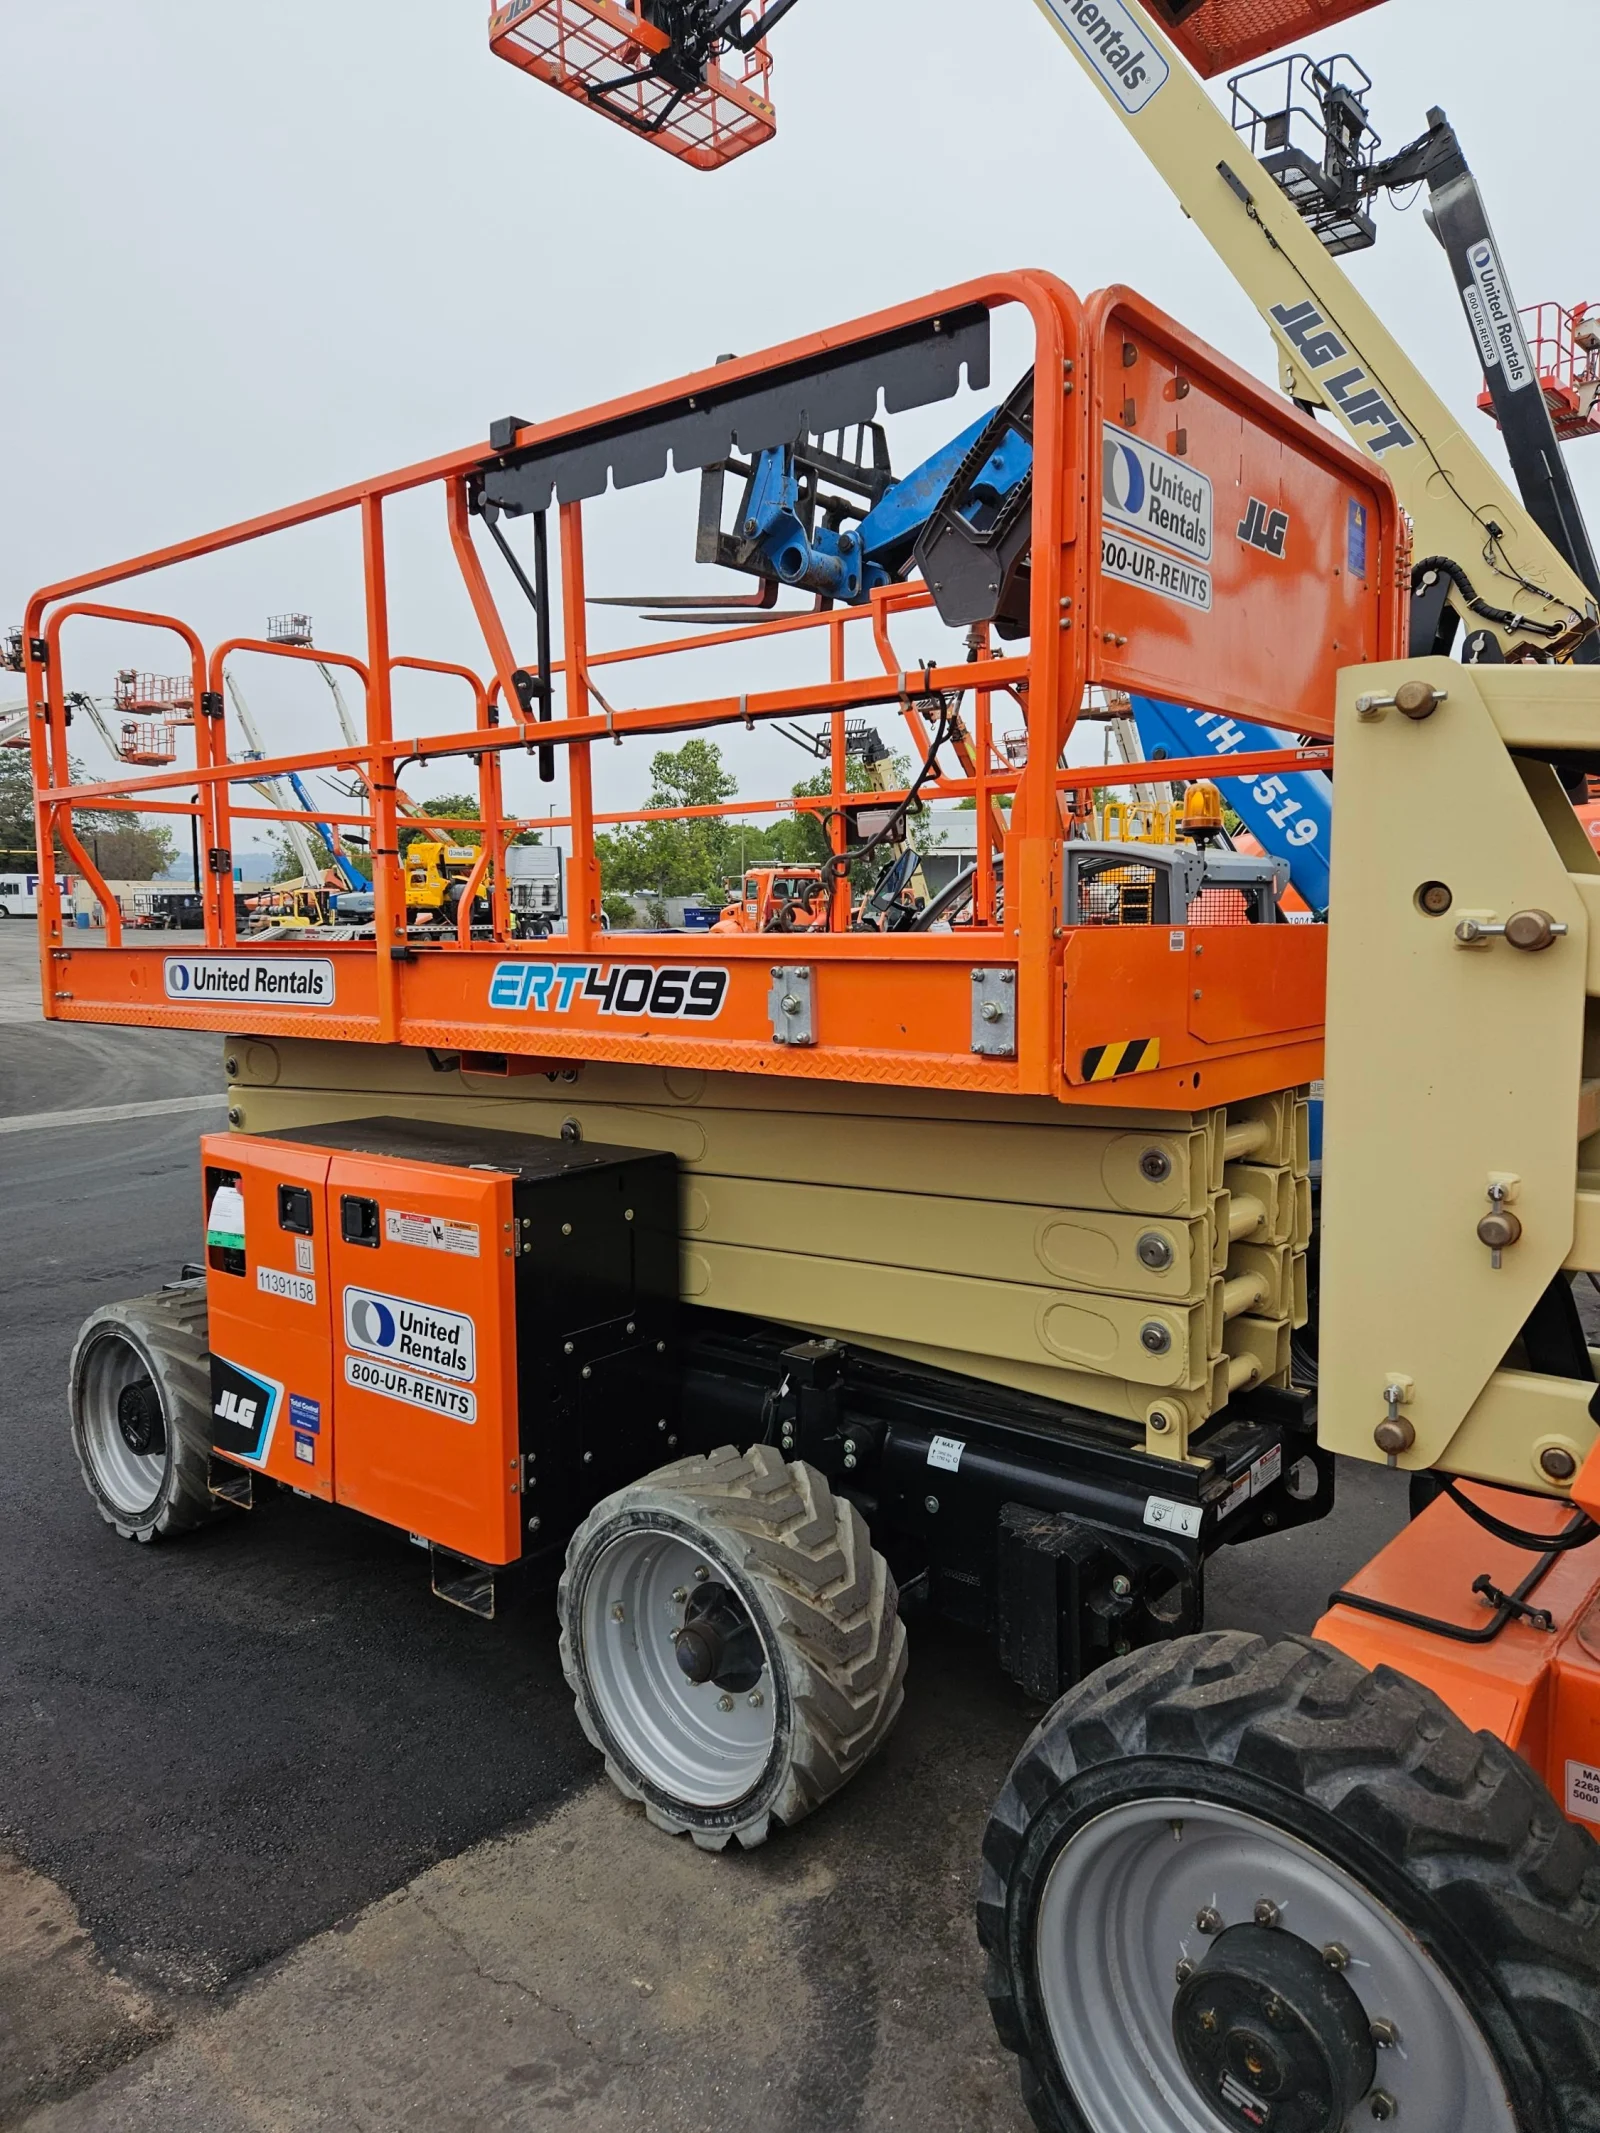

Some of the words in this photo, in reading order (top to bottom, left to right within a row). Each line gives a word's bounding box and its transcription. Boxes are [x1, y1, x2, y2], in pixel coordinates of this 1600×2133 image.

[1467, 292, 1495, 360] 800-UR-RENTS
[1480, 269, 1508, 322] United
[1497, 322, 1525, 381] Rentals
[1269, 300, 1348, 370] JLG
[1323, 367, 1415, 453] LIFT
[1150, 461, 1203, 514] United
[1148, 495, 1206, 547] Rentals
[1237, 497, 1289, 557] JLG
[194, 967, 250, 992] United
[255, 967, 323, 995] Rentals
[491, 965, 727, 1016] ERT4069
[260, 1272, 313, 1301] 11391158
[400, 1310, 460, 1345] United
[400, 1334, 467, 1371] Rentals
[214, 1390, 257, 1429] JLG
[352, 1364, 469, 1414] 800-UR-RENTS
[942, 1441, 954, 1449] MAX
[1573, 1790, 1599, 1804] 5000
